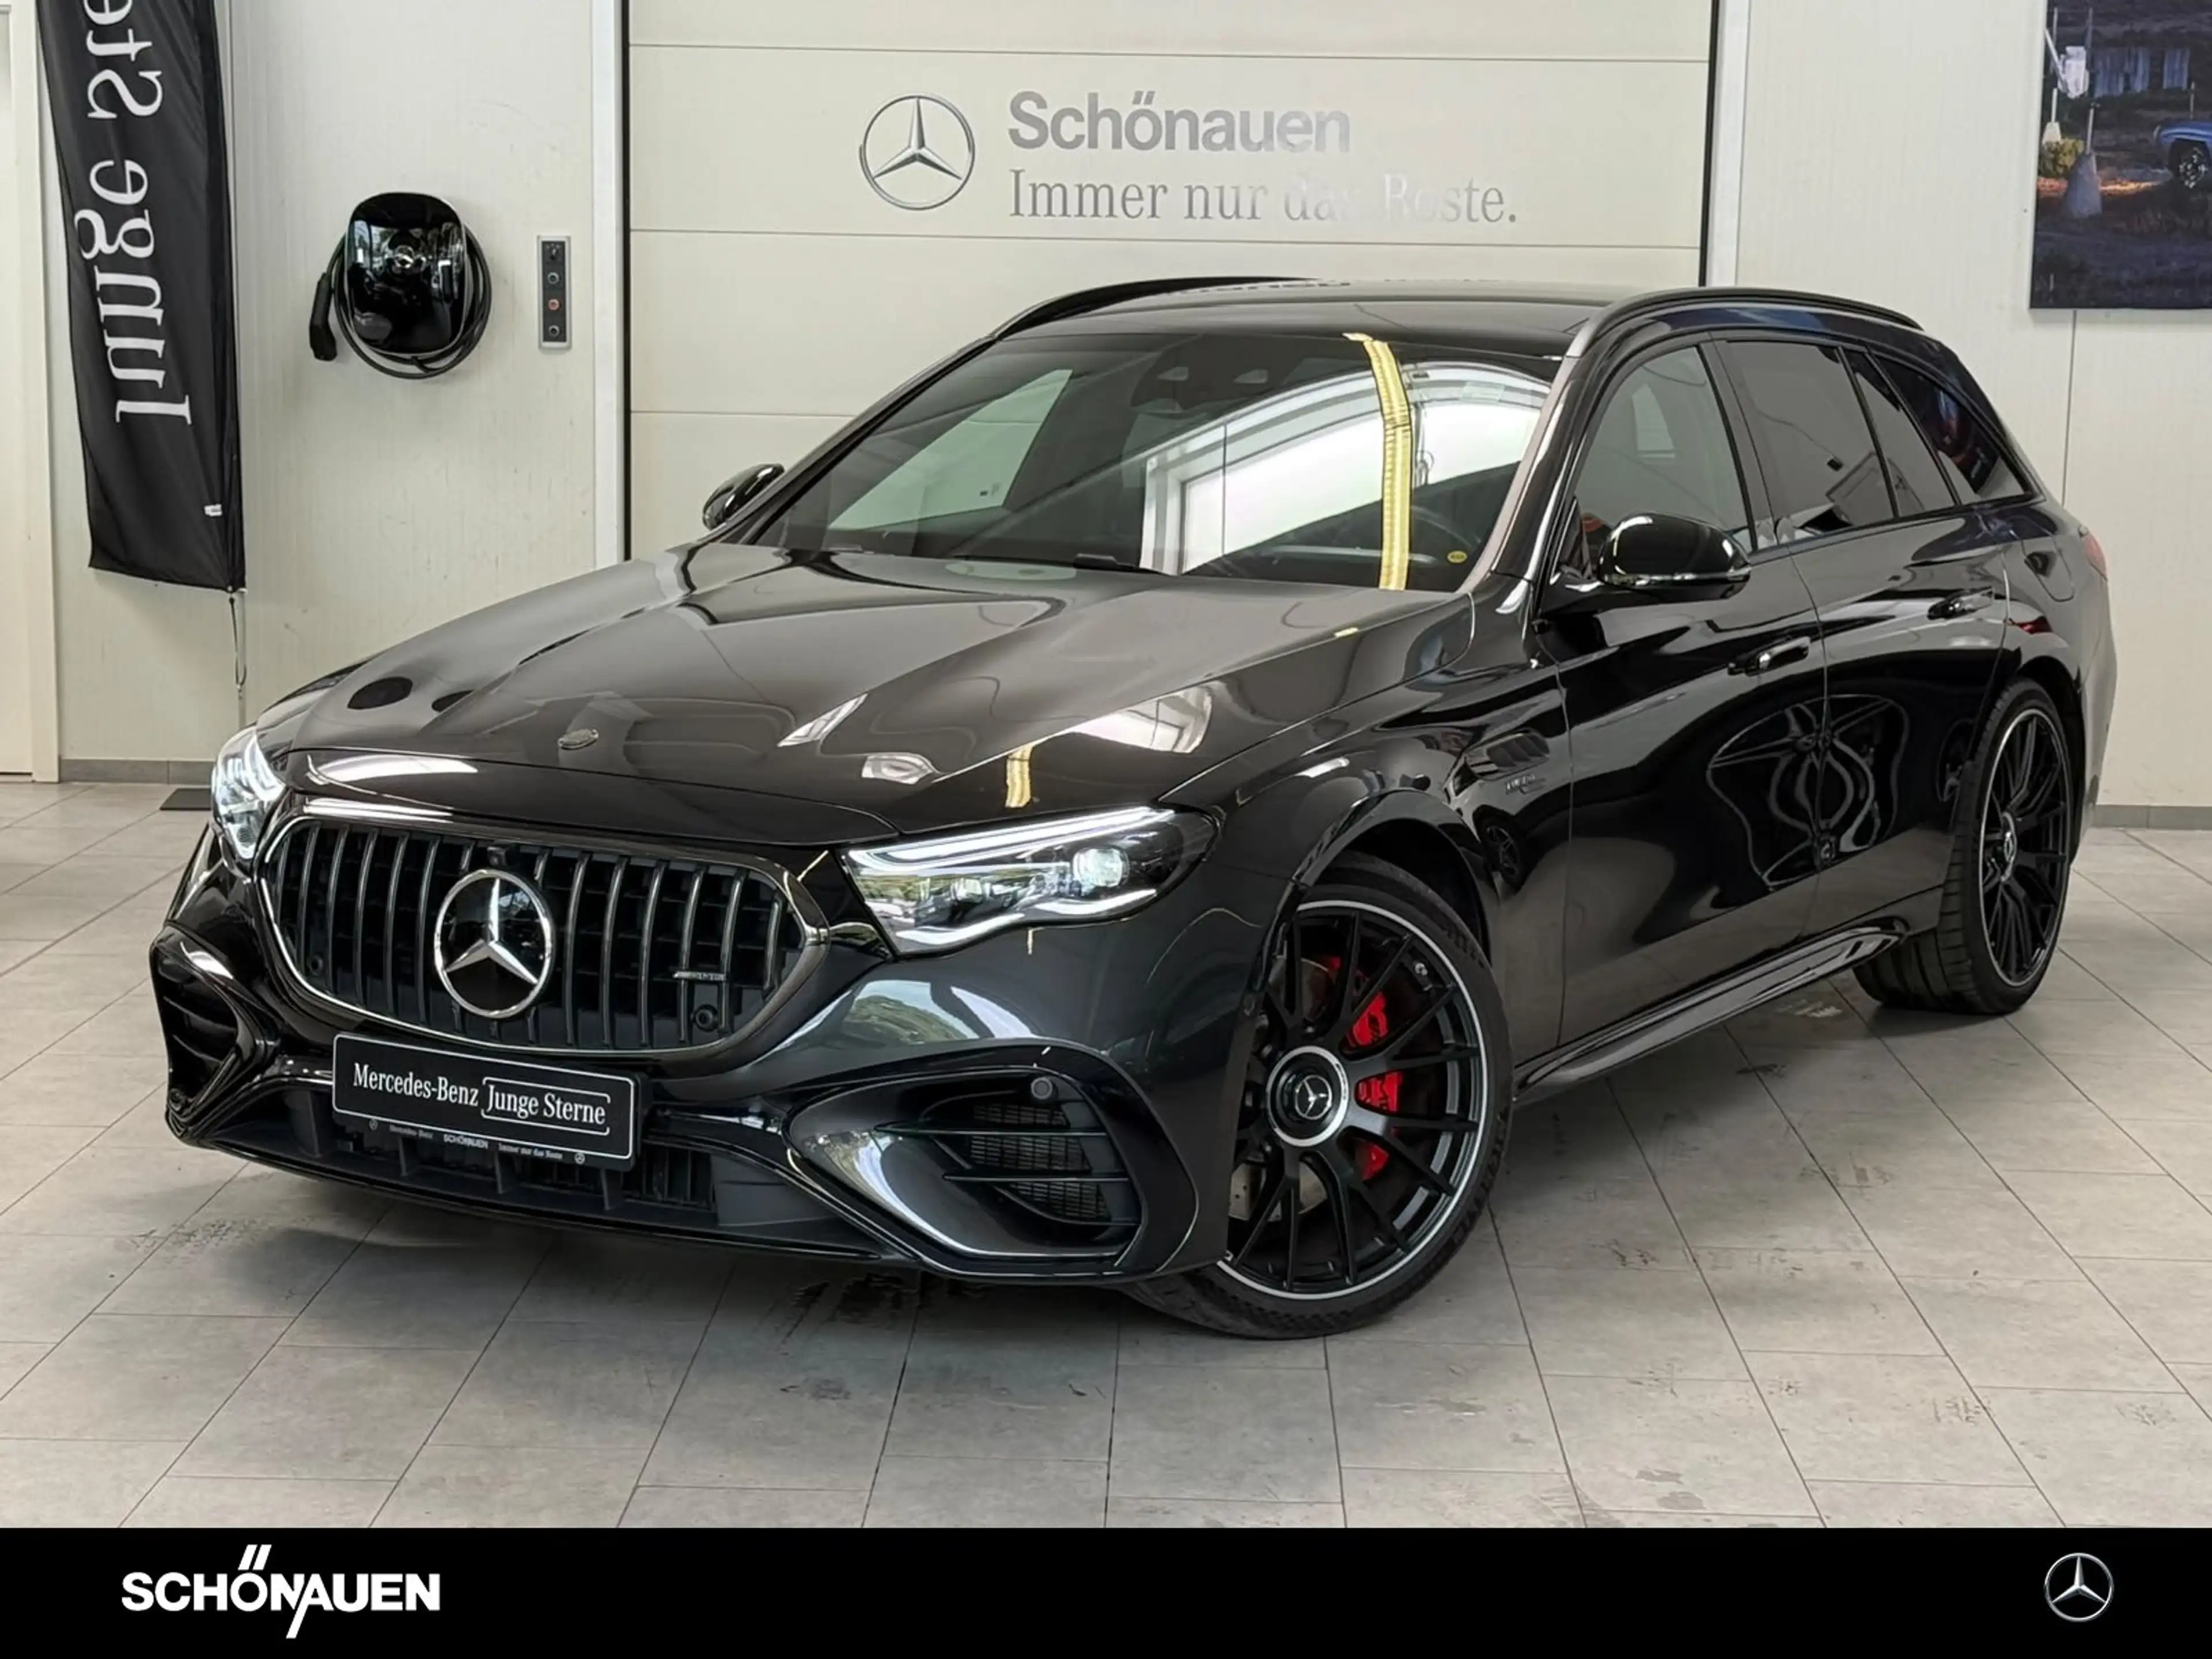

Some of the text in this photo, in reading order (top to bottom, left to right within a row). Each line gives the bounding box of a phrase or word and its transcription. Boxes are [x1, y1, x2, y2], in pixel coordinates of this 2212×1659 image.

[1008, 90, 1350, 153] Schönauen
[1009, 168, 1168, 220] Immer
[1183, 183, 1268, 221] nur
[353, 1062, 606, 1125] Mercedes-Benz Junge Sterne
